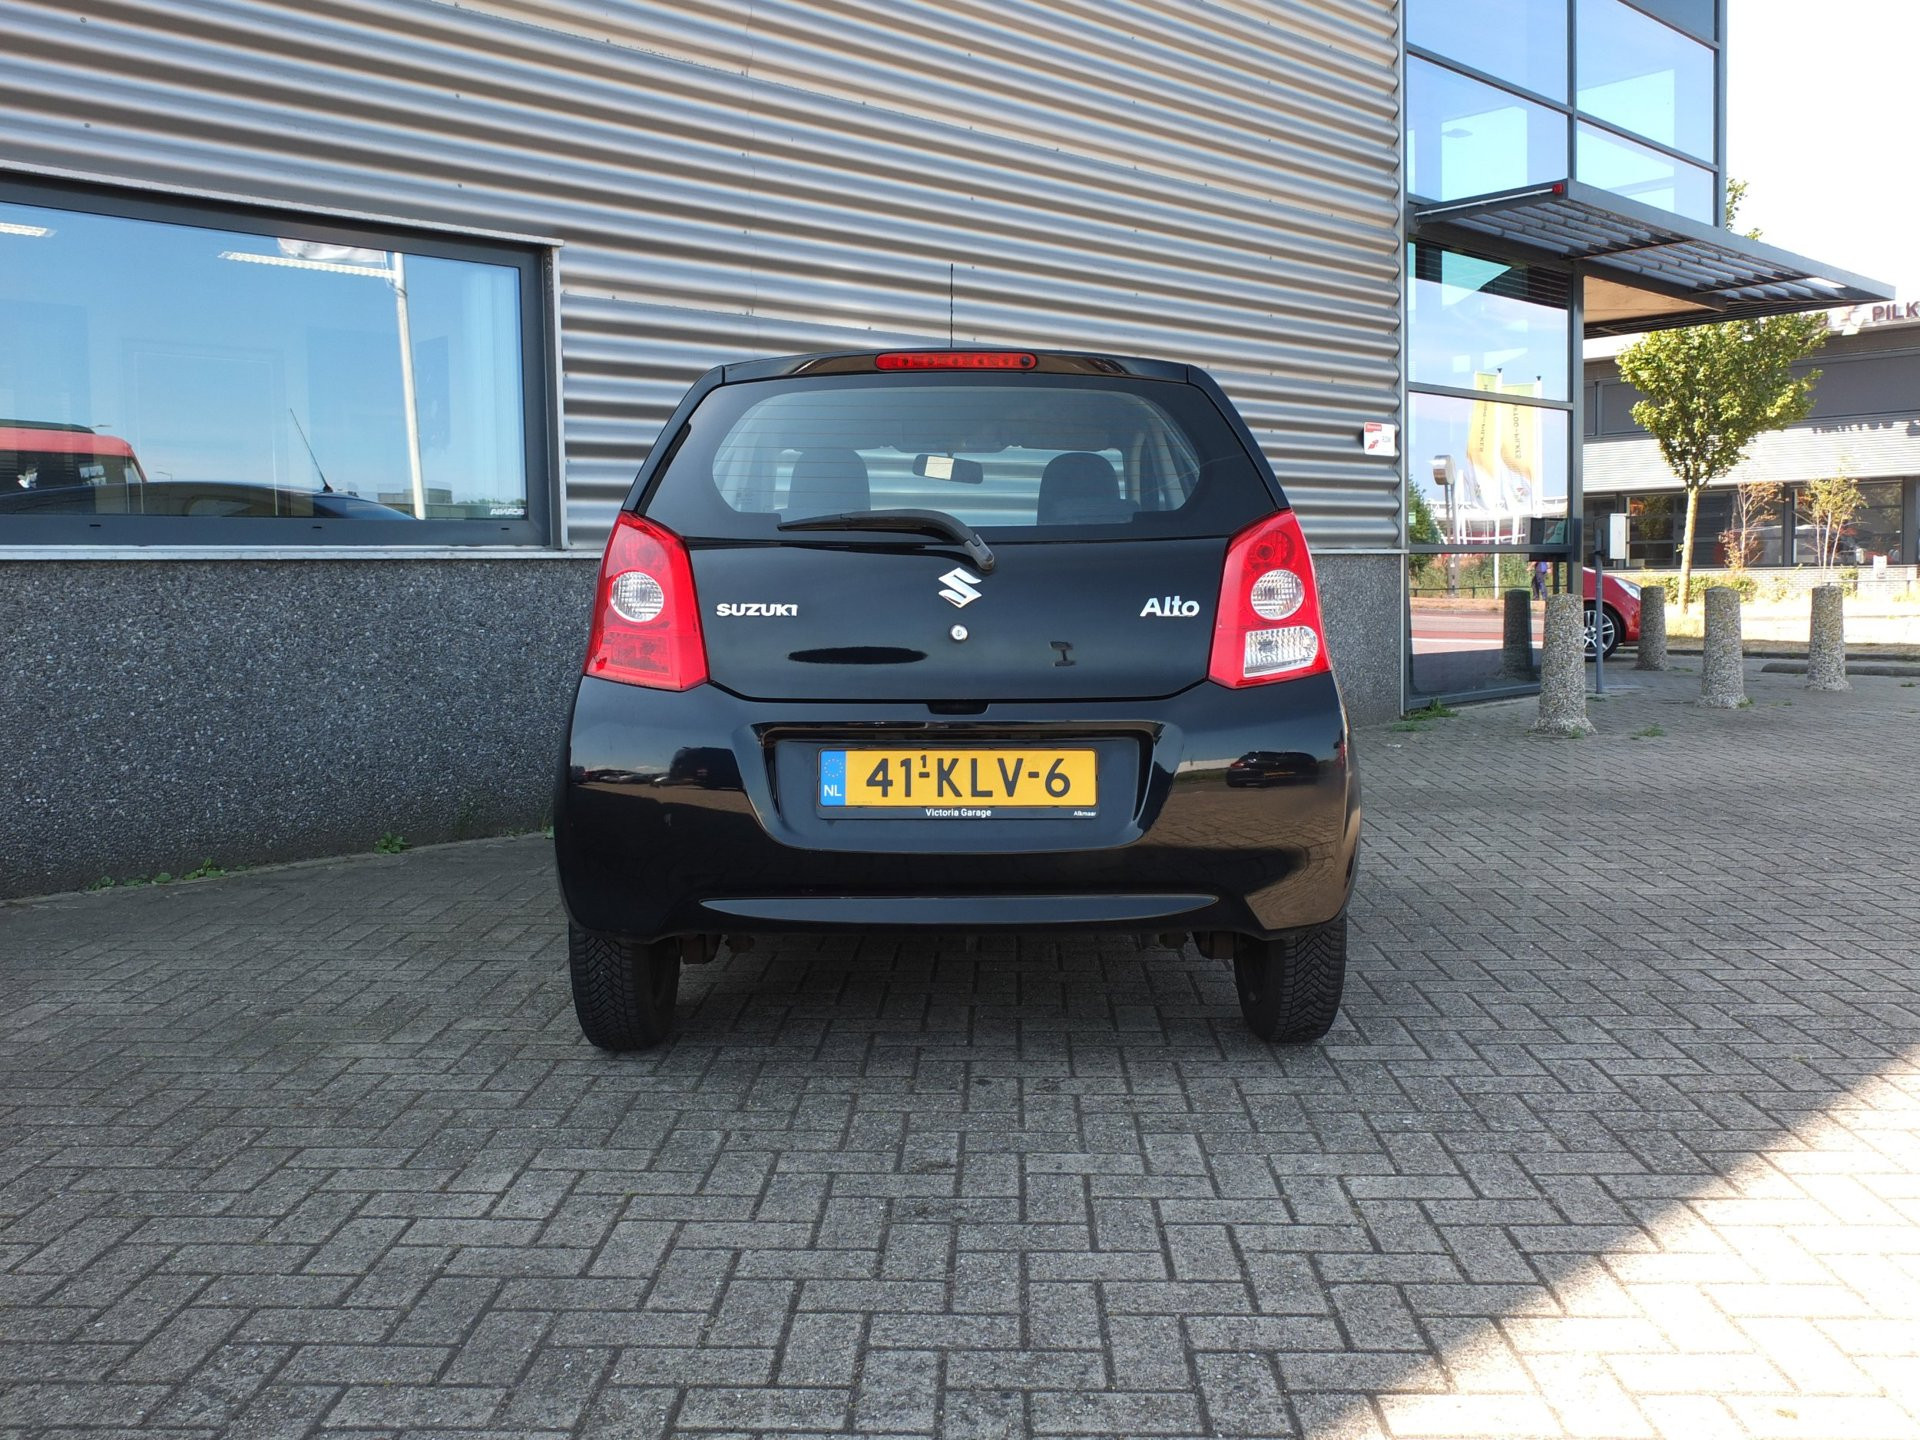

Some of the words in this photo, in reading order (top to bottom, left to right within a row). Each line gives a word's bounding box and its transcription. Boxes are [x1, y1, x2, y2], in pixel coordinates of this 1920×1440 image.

[716, 603, 798, 617] SUZUKI
[1140, 595, 1200, 617] Alto
[824, 785, 842, 797] NL
[925, 808, 959, 817] Victoria
[960, 808, 992, 818] Garage
